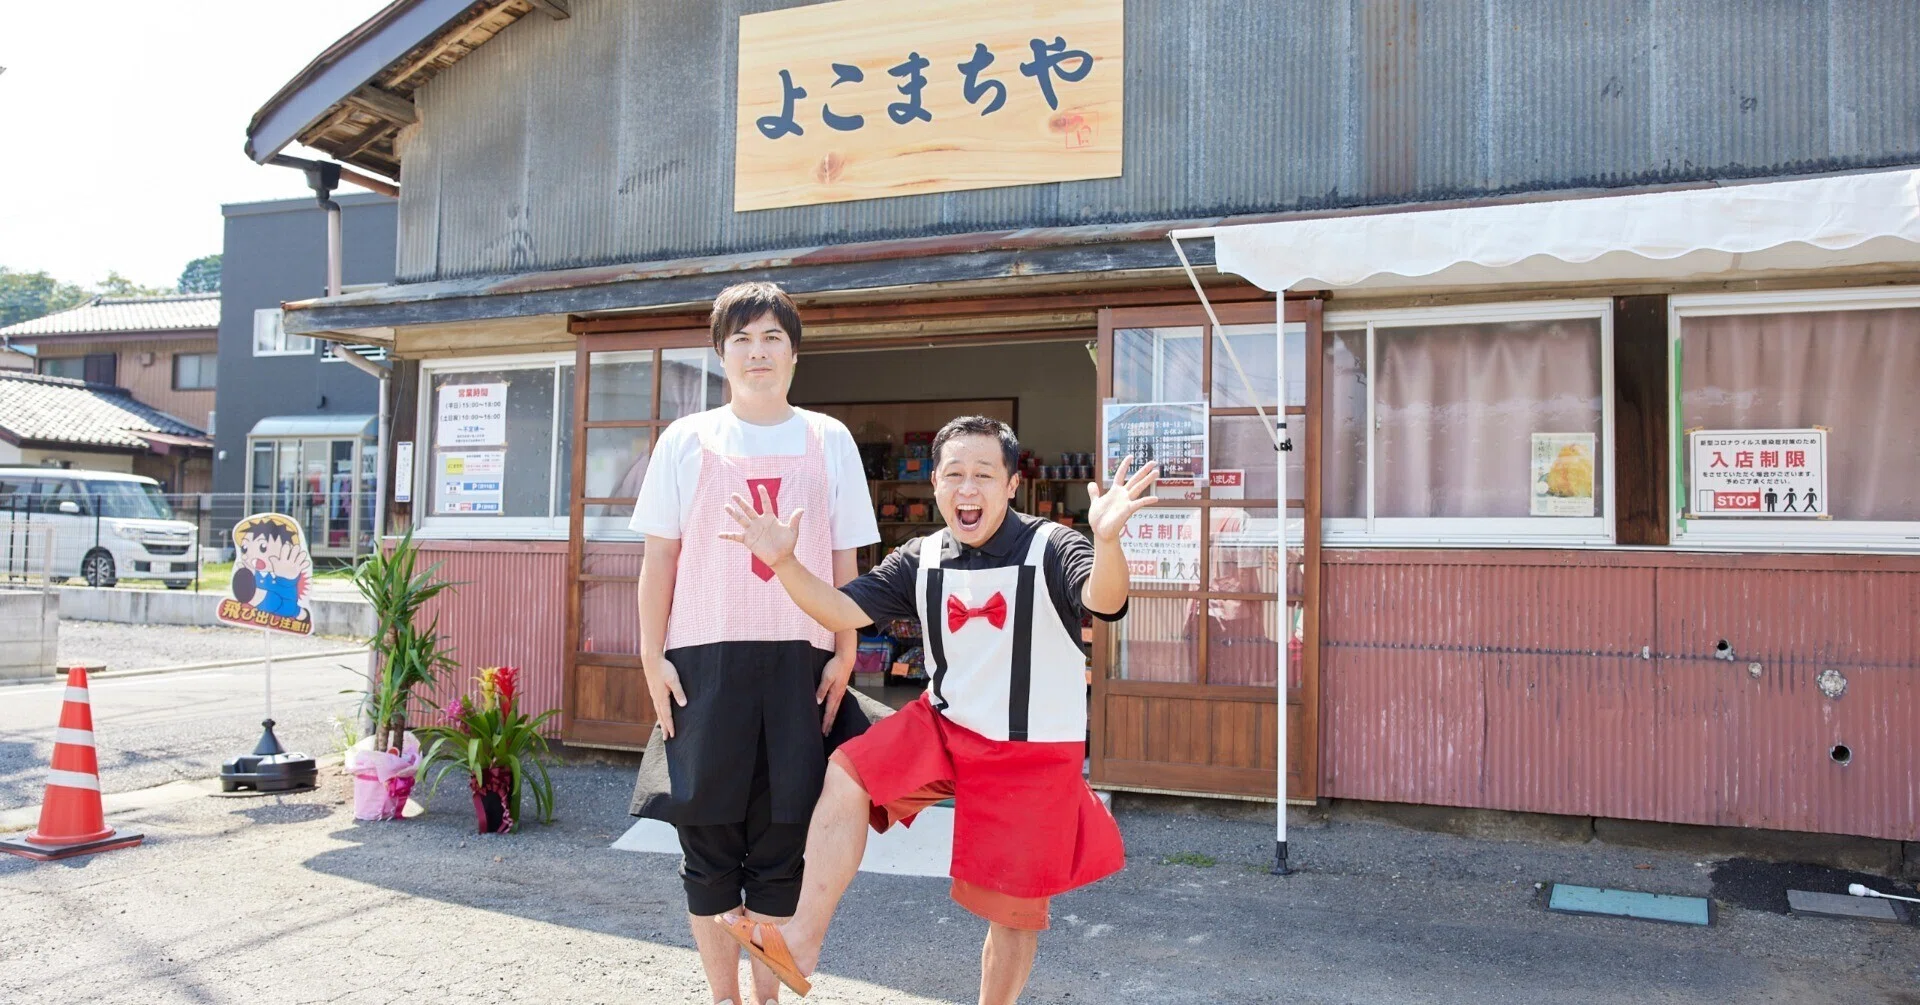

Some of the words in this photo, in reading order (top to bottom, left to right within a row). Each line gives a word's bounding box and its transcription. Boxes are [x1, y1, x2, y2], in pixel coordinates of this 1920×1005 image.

[756, 36, 1094, 140] よこまちや
[458, 388, 488, 397] 営業時間
[1710, 450, 1805, 468] 入店制限
[1717, 495, 1757, 506] STOP
